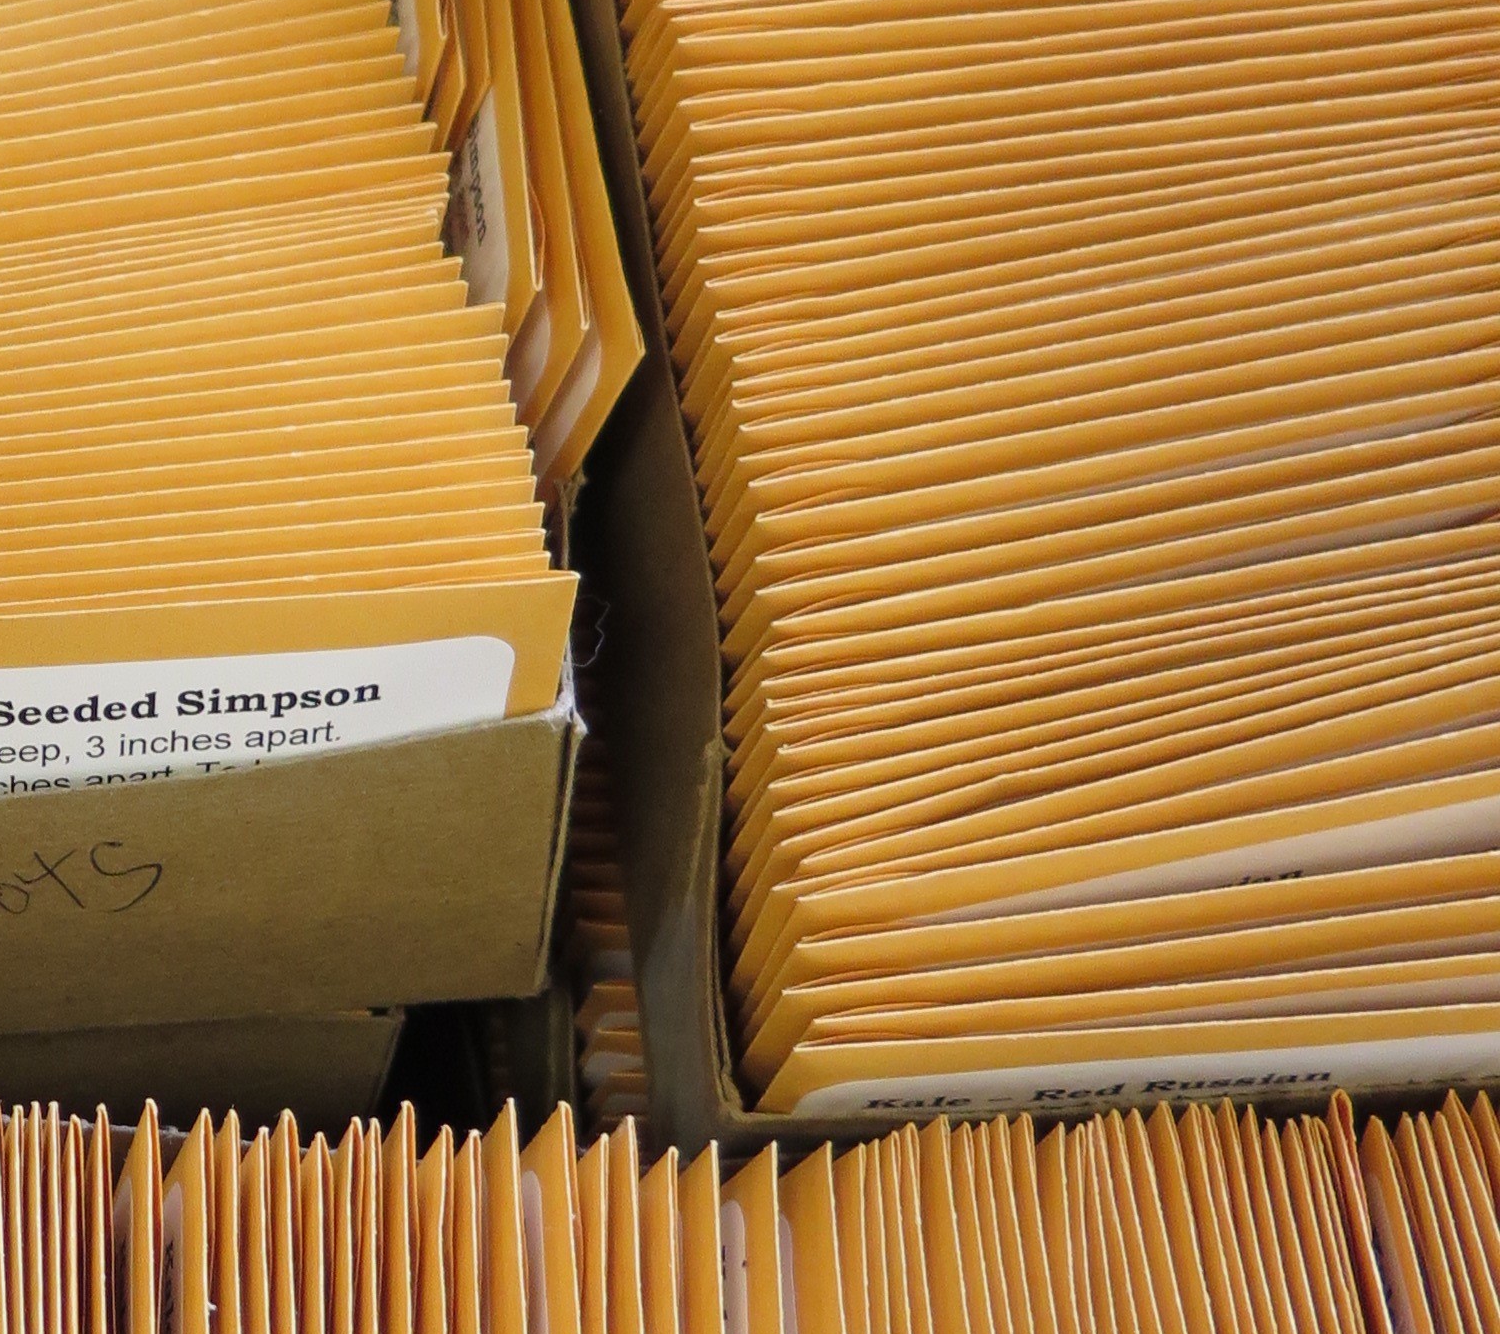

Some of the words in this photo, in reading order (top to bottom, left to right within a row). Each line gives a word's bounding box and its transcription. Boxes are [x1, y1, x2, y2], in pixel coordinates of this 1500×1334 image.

[176, 683, 382, 718] Simpson
[85, 735, 106, 758] 3
[119, 729, 232, 757] inches
[244, 720, 342, 748] apart.
[864, 1095, 971, 1110] Kale
[1029, 1082, 1126, 1102] Red
[1140, 1071, 1331, 1093] Russian
